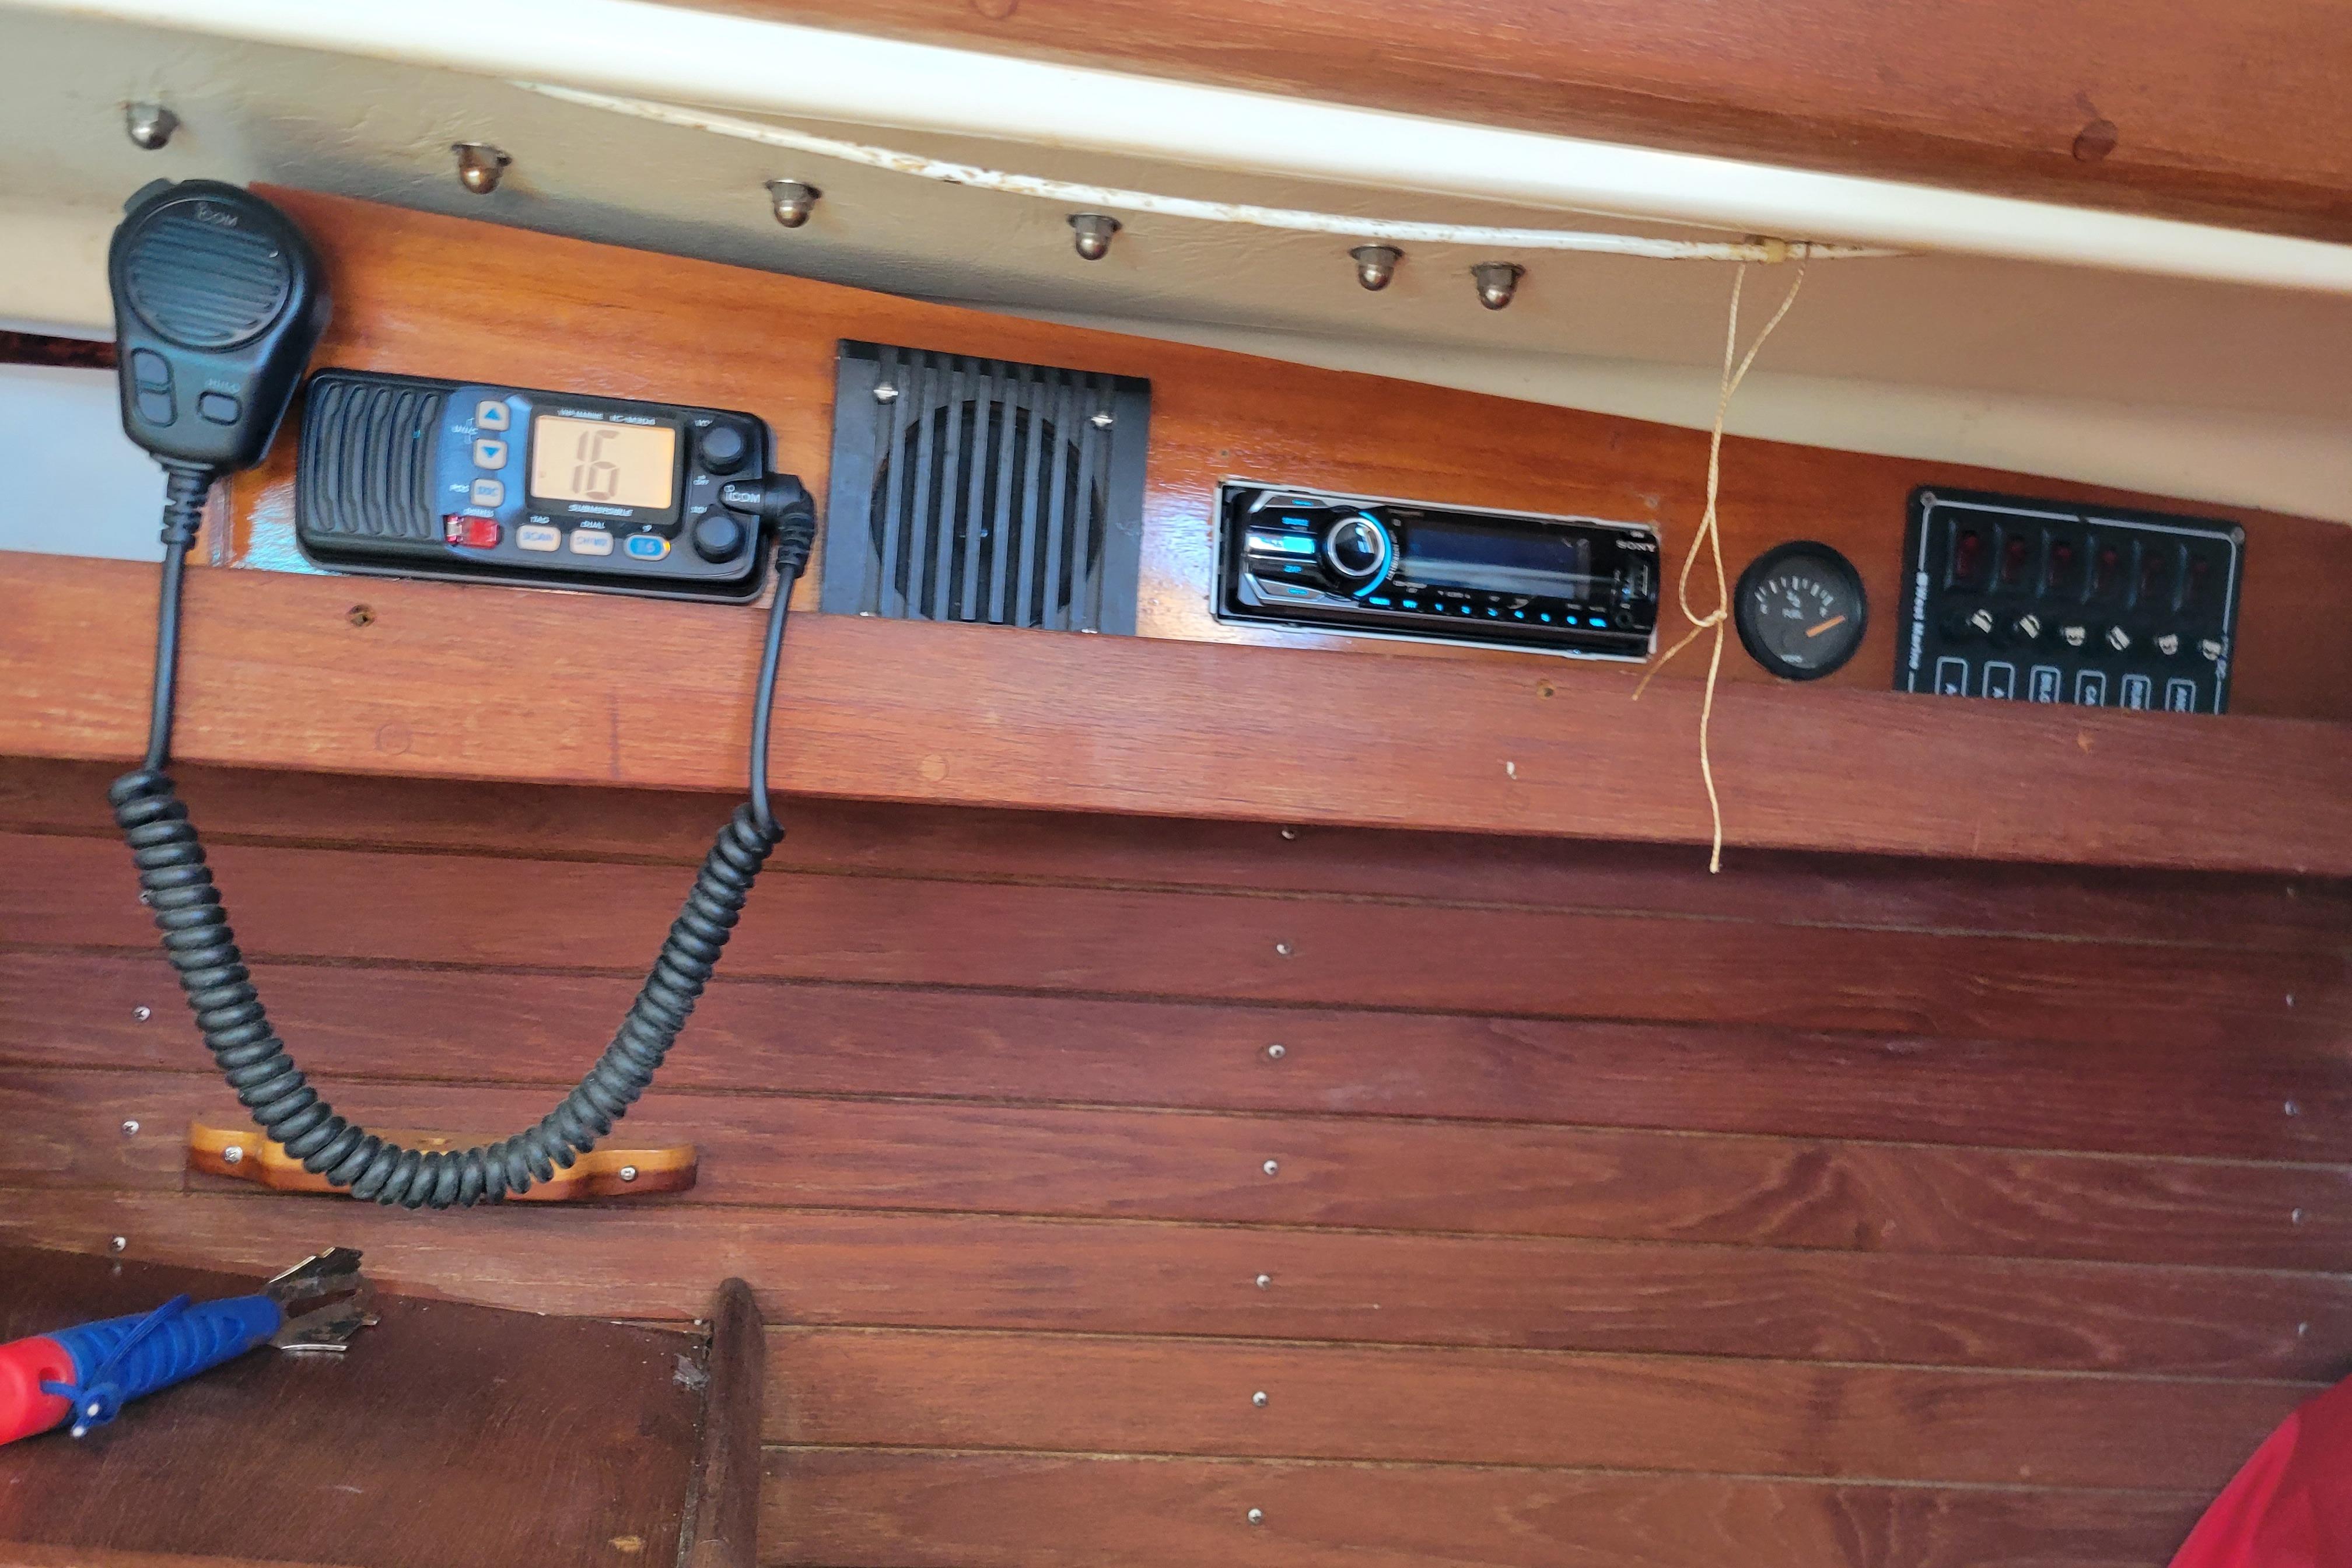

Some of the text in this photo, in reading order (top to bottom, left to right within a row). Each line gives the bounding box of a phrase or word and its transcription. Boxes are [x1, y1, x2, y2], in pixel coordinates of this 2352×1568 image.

[572, 429, 621, 501] 16
[568, 504, 634, 517] SUBMERSIBLE
[1615, 540, 1657, 552] SONY
